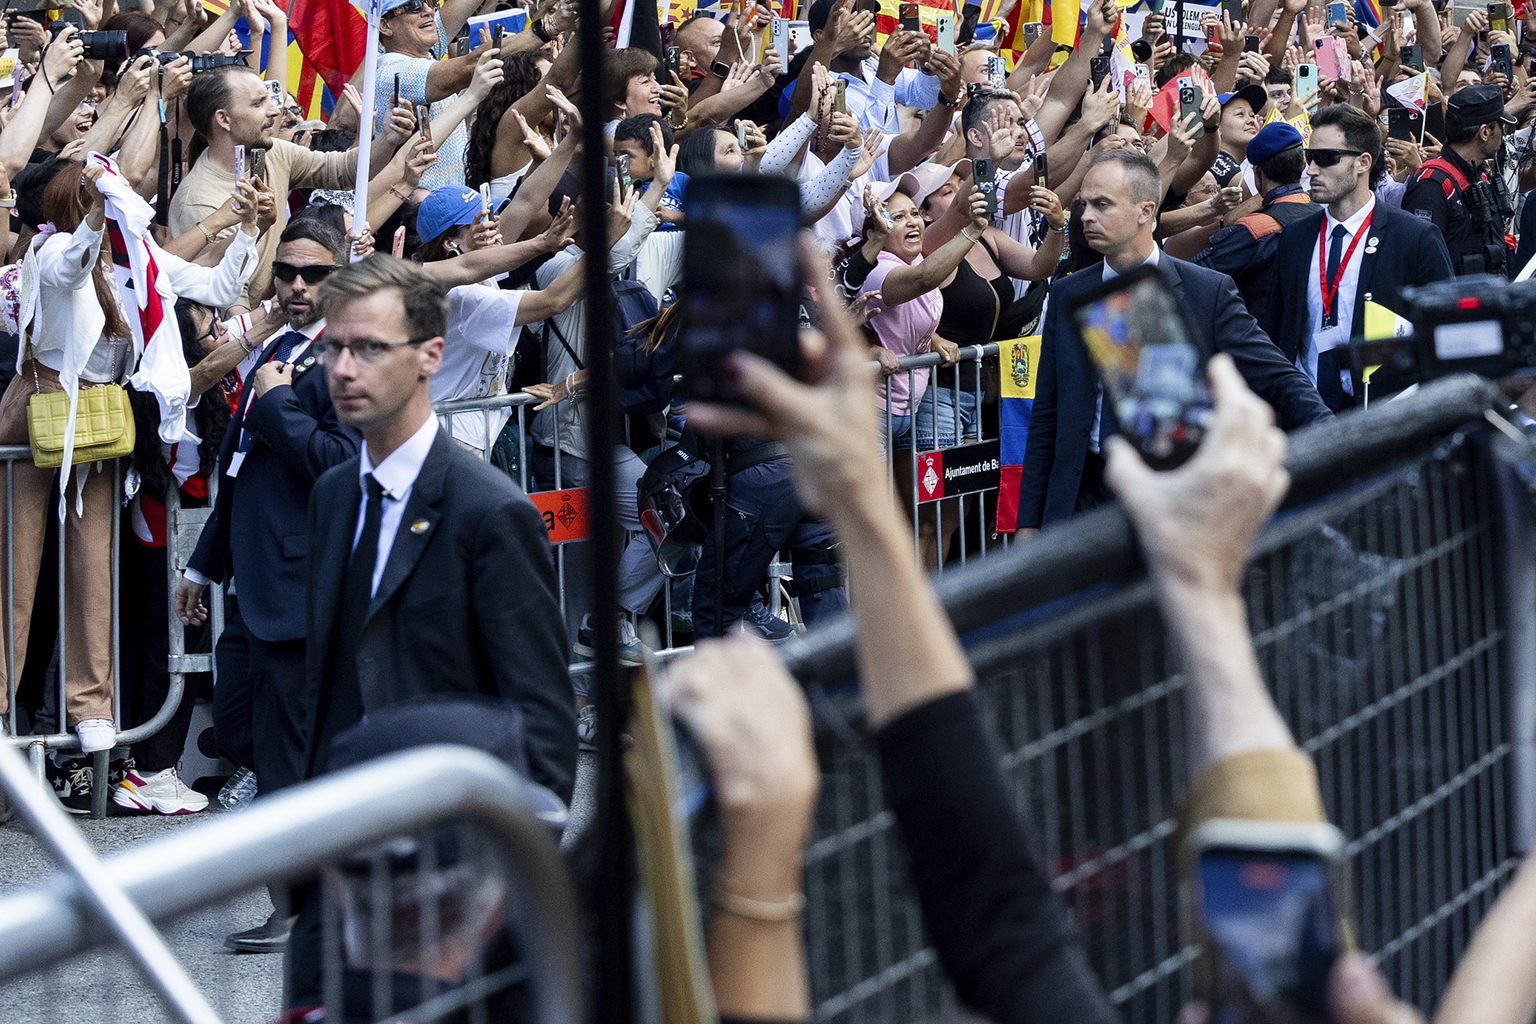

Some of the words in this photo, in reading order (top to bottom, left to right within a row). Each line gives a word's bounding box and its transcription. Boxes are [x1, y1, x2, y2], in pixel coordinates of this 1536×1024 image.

[1165, 7, 1176, 18] US
[944, 462, 982, 481] Ajuntament
[982, 460, 991, 472] de
[991, 458, 1000, 470] Ba
